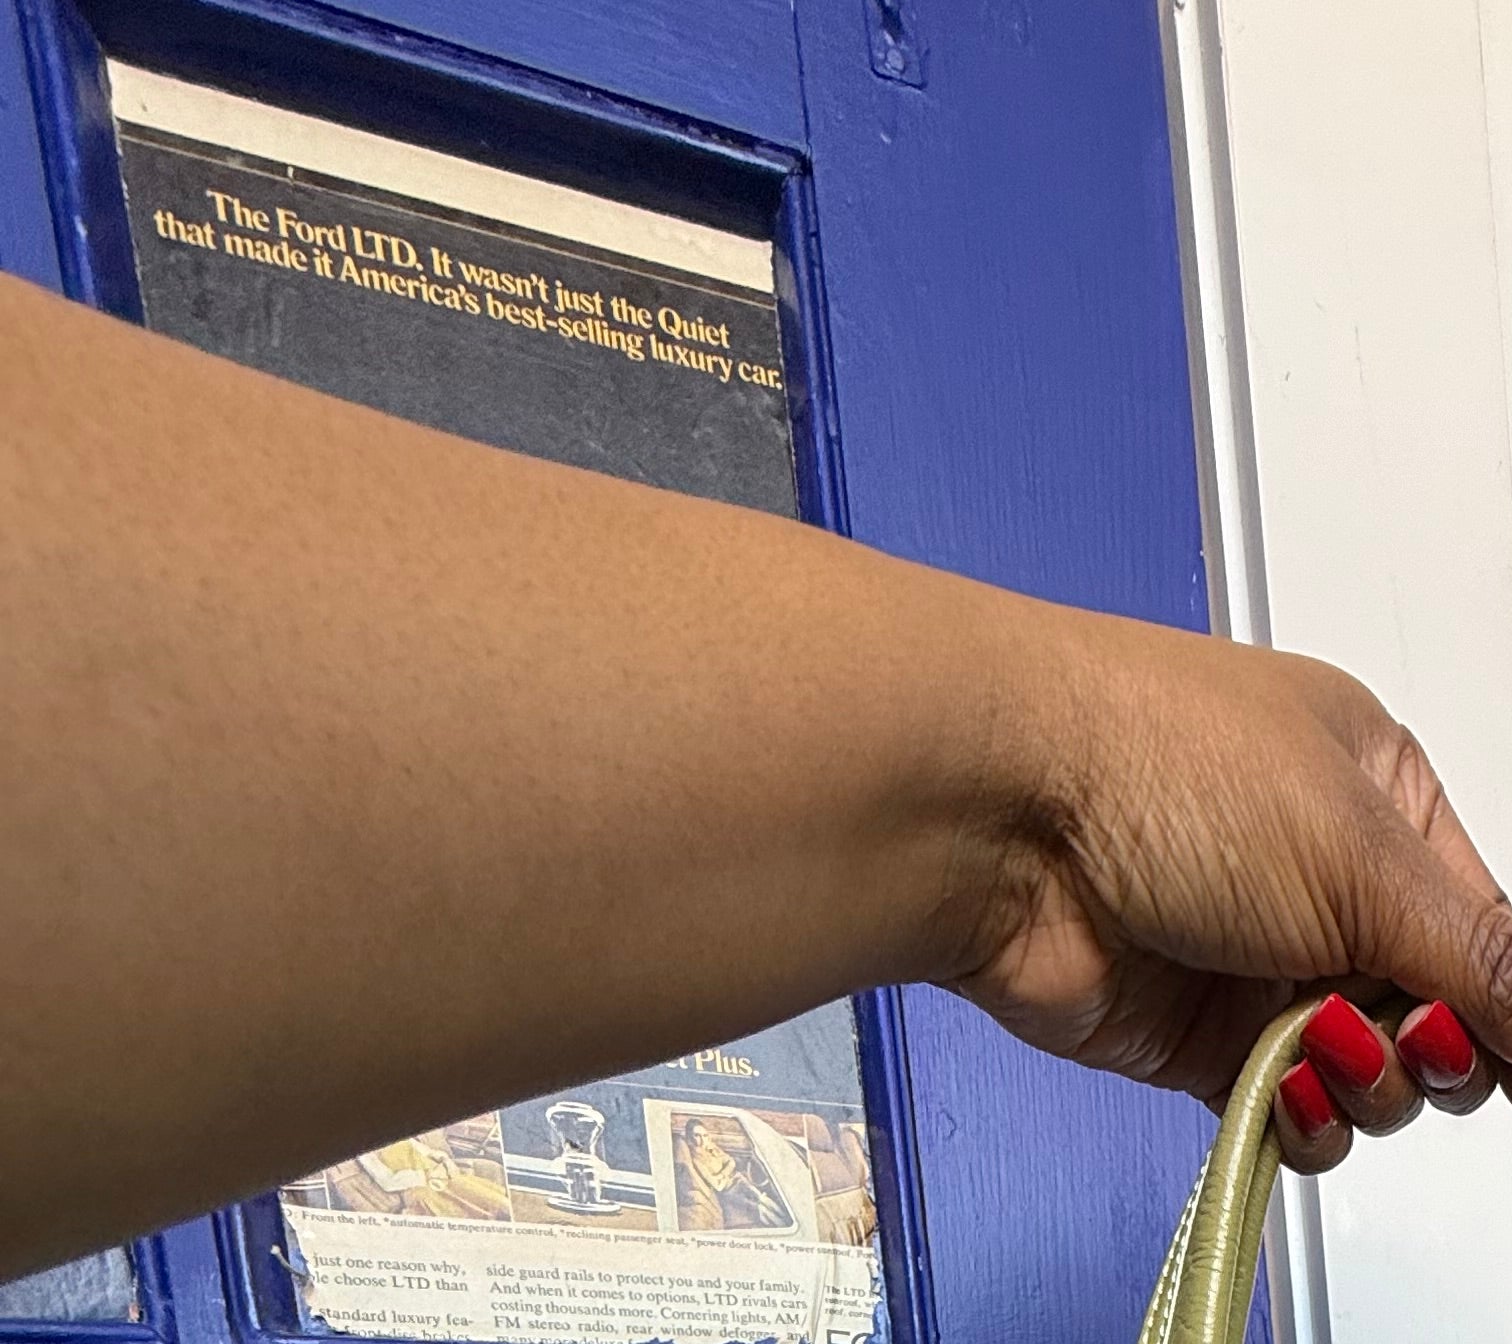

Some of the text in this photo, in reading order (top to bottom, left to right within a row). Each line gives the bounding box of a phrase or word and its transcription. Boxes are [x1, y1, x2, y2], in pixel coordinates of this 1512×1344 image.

[206, 189, 730, 350] The Ford LTD. It wasn't just the Quiet
[154, 210, 784, 391] that made it America's best-selling luxury car.
[694, 1049, 759, 1077] Plus.
[313, 1252, 466, 1276] just one reason why,
[486, 1264, 805, 1296] side guard rails to protect you and your family.
